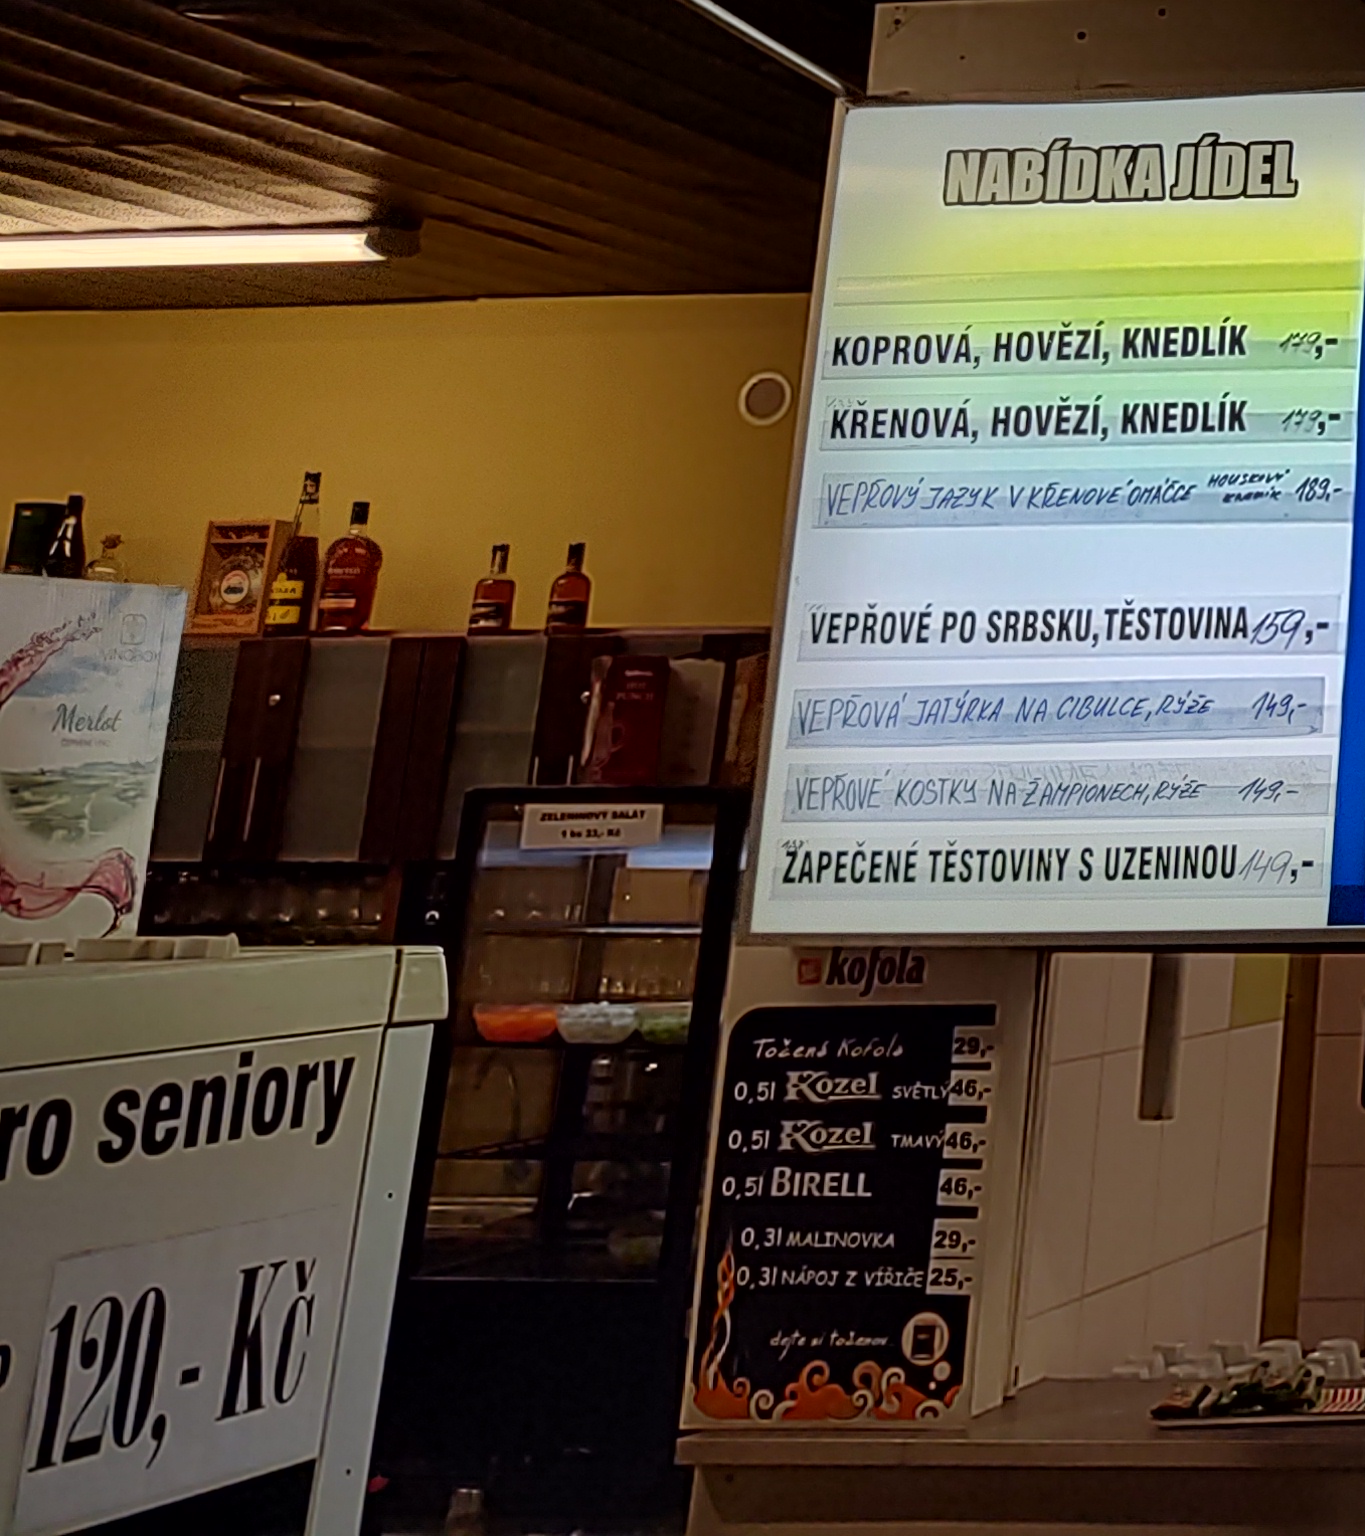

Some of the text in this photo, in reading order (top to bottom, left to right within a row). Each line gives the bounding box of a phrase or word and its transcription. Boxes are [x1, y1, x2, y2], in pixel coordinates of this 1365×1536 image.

[943, 133, 1299, 206] NABÍDKA JÍDEL
[831, 317, 1249, 369] KOPROVÁ, HOVĚZÍ, KNEDLÍK
[829, 392, 1247, 445] KŘENOVÁ, HOVĚZÍ, KNEDLÍK
[1008, 487, 1023, 507] V
[810, 603, 933, 646] VEPŘOVÉ
[940, 610, 977, 643] PO
[51, 703, 123, 733] Merlot
[1014, 696, 1049, 724] NA
[894, 778, 978, 805] KOSTKY
[986, 780, 1018, 806] NA
[782, 840, 917, 884] ZAPEČENÉ
[928, 841, 1071, 884] TĚSTOVINY
[1078, 847, 1093, 881] S
[1103, 843, 1239, 882] UZENINOU
[825, 947, 926, 997] kofola
[952, 1036, 995, 1057] 29,-
[783, 1070, 882, 1103] Kozel
[949, 1079, 992, 1099] 46,-
[97, 1050, 355, 1164] seniory
[778, 1120, 876, 1151] Kozel
[944, 1130, 987, 1150] 46,-
[770, 1166, 873, 1198] BIRELL
[939, 1176, 983, 1197] 46,-
[785, 1231, 896, 1249] MALINOVKA
[933, 1229, 976, 1250] 29,-
[781, 1265, 840, 1286] NÁPOJ
[845, 1269, 857, 1286] Z
[929, 1267, 973, 1287] 25,-
[27, 1256, 317, 1473] 120,- Kč
